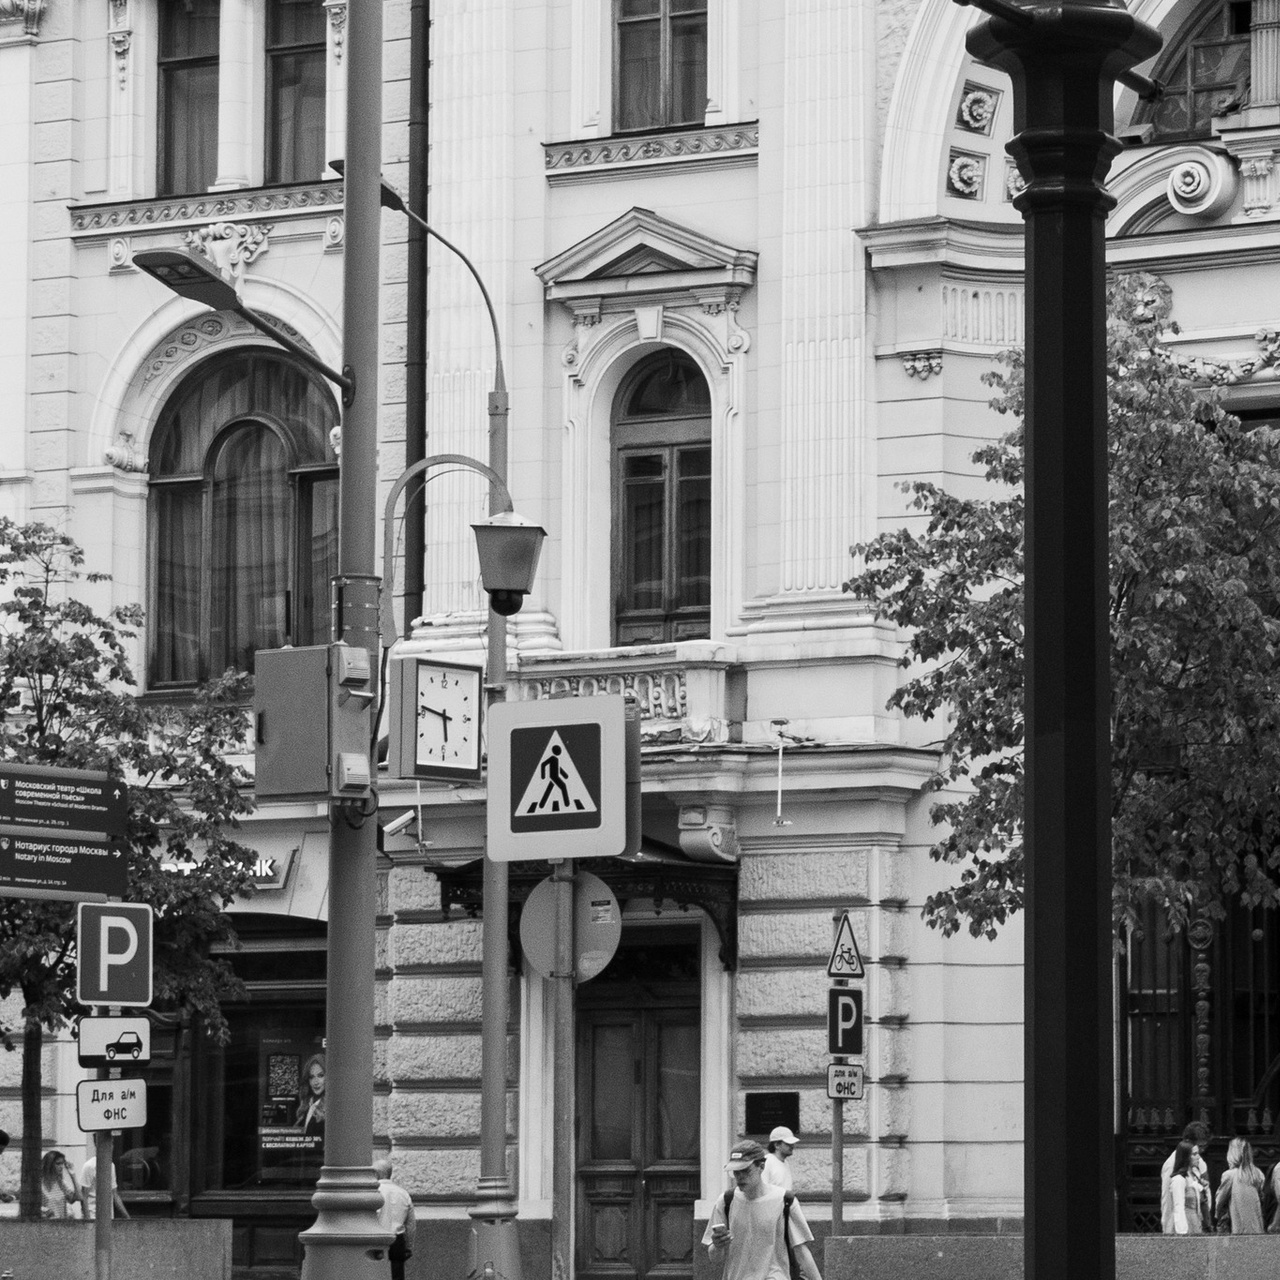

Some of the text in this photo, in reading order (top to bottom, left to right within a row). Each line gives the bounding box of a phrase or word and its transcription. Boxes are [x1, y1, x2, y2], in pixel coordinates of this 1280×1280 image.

[15, 780, 56, 791] Московский
[57, 784, 76, 793] театр
[15, 790, 60, 799] современной
[15, 840, 108, 856] Нотариус города Москвы
[15, 853, 72, 864] Notary in Moscow
[91, 1088, 136, 1103] Для а/м
[836, 1082, 856, 1096] ФНС
[103, 1107, 127, 1120] ФНС
